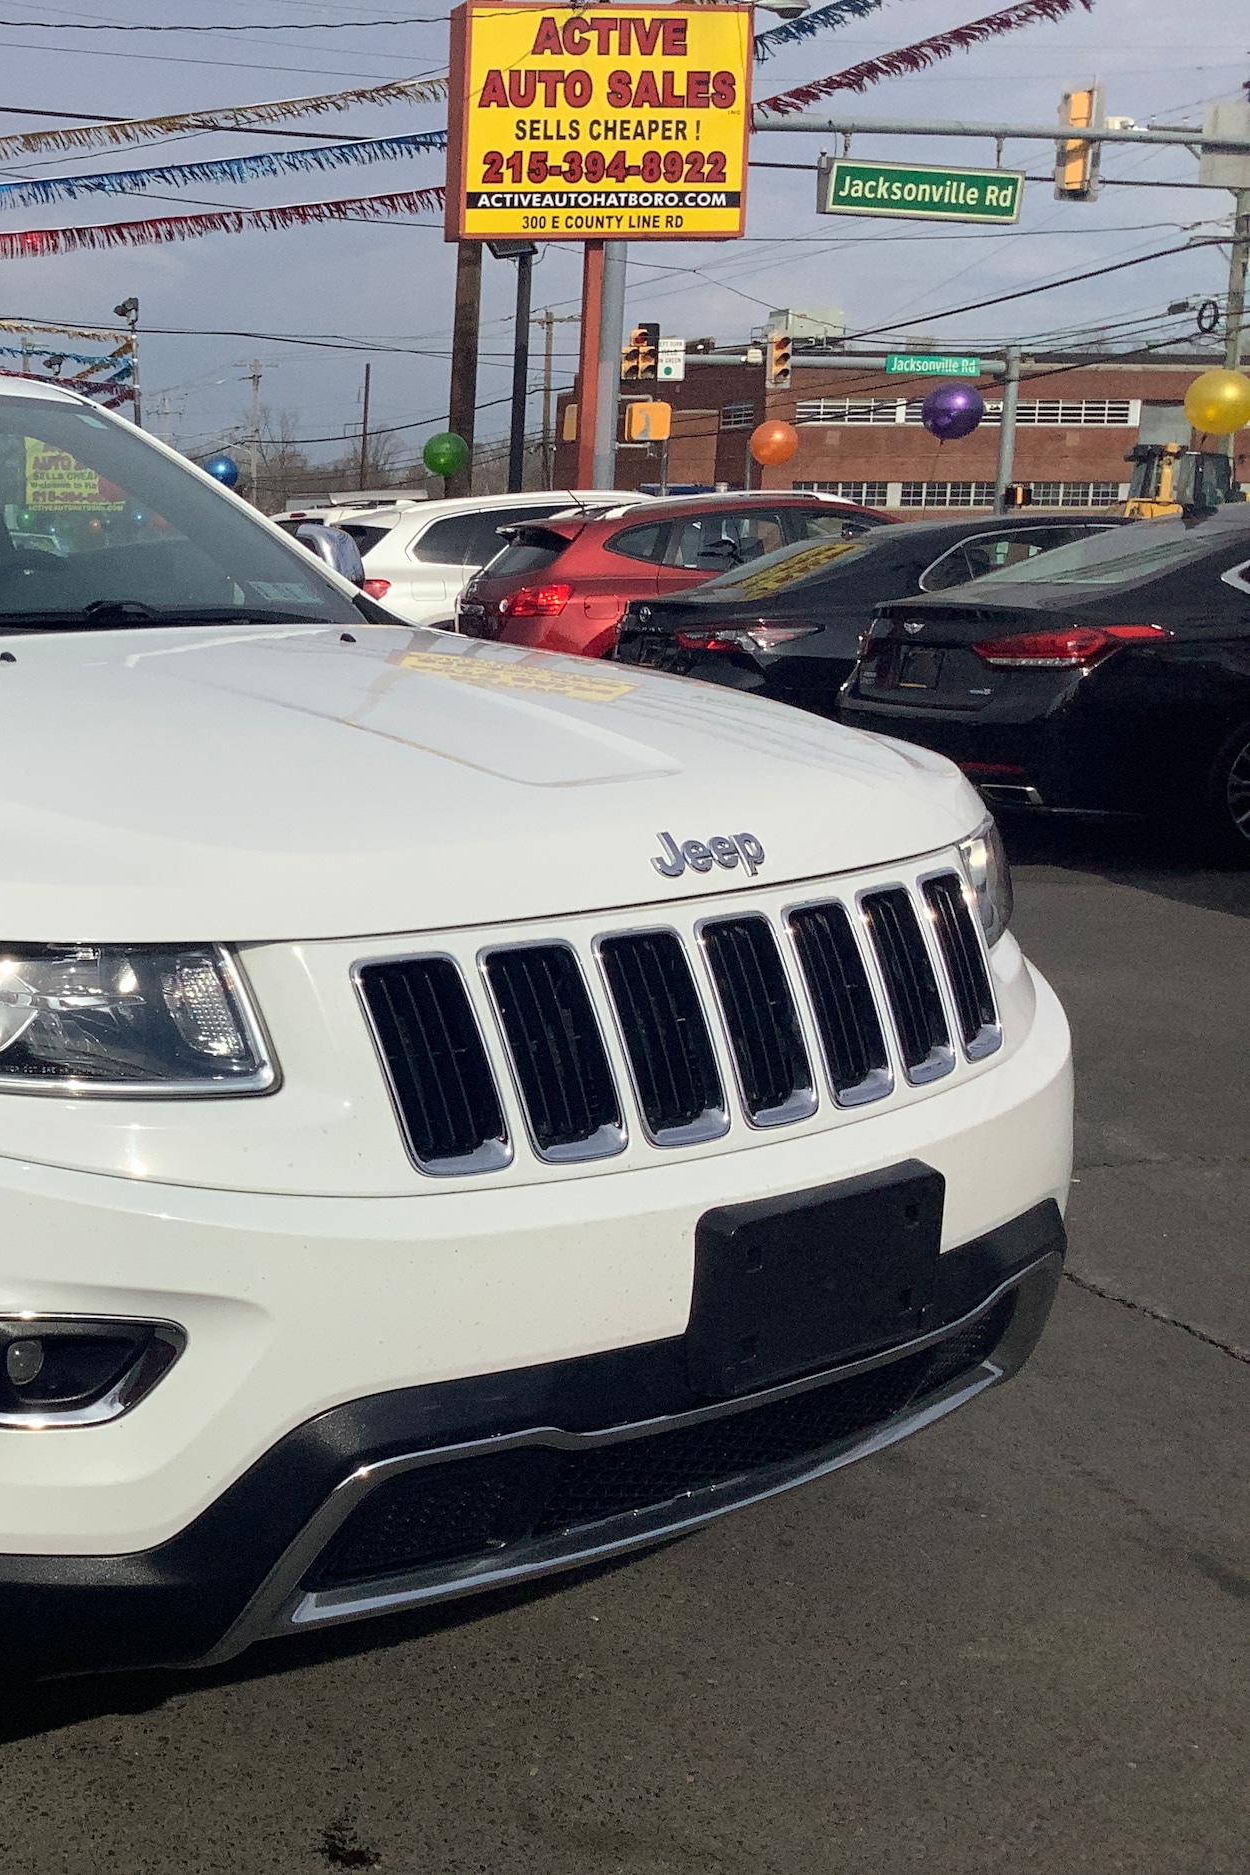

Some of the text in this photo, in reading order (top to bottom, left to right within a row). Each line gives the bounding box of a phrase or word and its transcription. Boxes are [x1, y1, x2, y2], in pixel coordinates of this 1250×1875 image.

[531, 17, 688, 56] ACTIVE
[478, 69, 737, 109] AUTO SALES
[515, 119, 580, 141] SELLS
[589, 119, 688, 141] CHEAPER
[481, 150, 727, 184] 215-394-8922
[477, 193, 727, 208] ACTIVEAUTOHATBORO.COM
[839, 175, 1013, 208] Jacksonville Rd
[522, 215, 684, 229] 300 E COUNTY LINE RD
[891, 357, 976, 373] Jacksonville Rd
[33, 472, 64, 481] SELLS
[650, 831, 765, 879] Jeep
